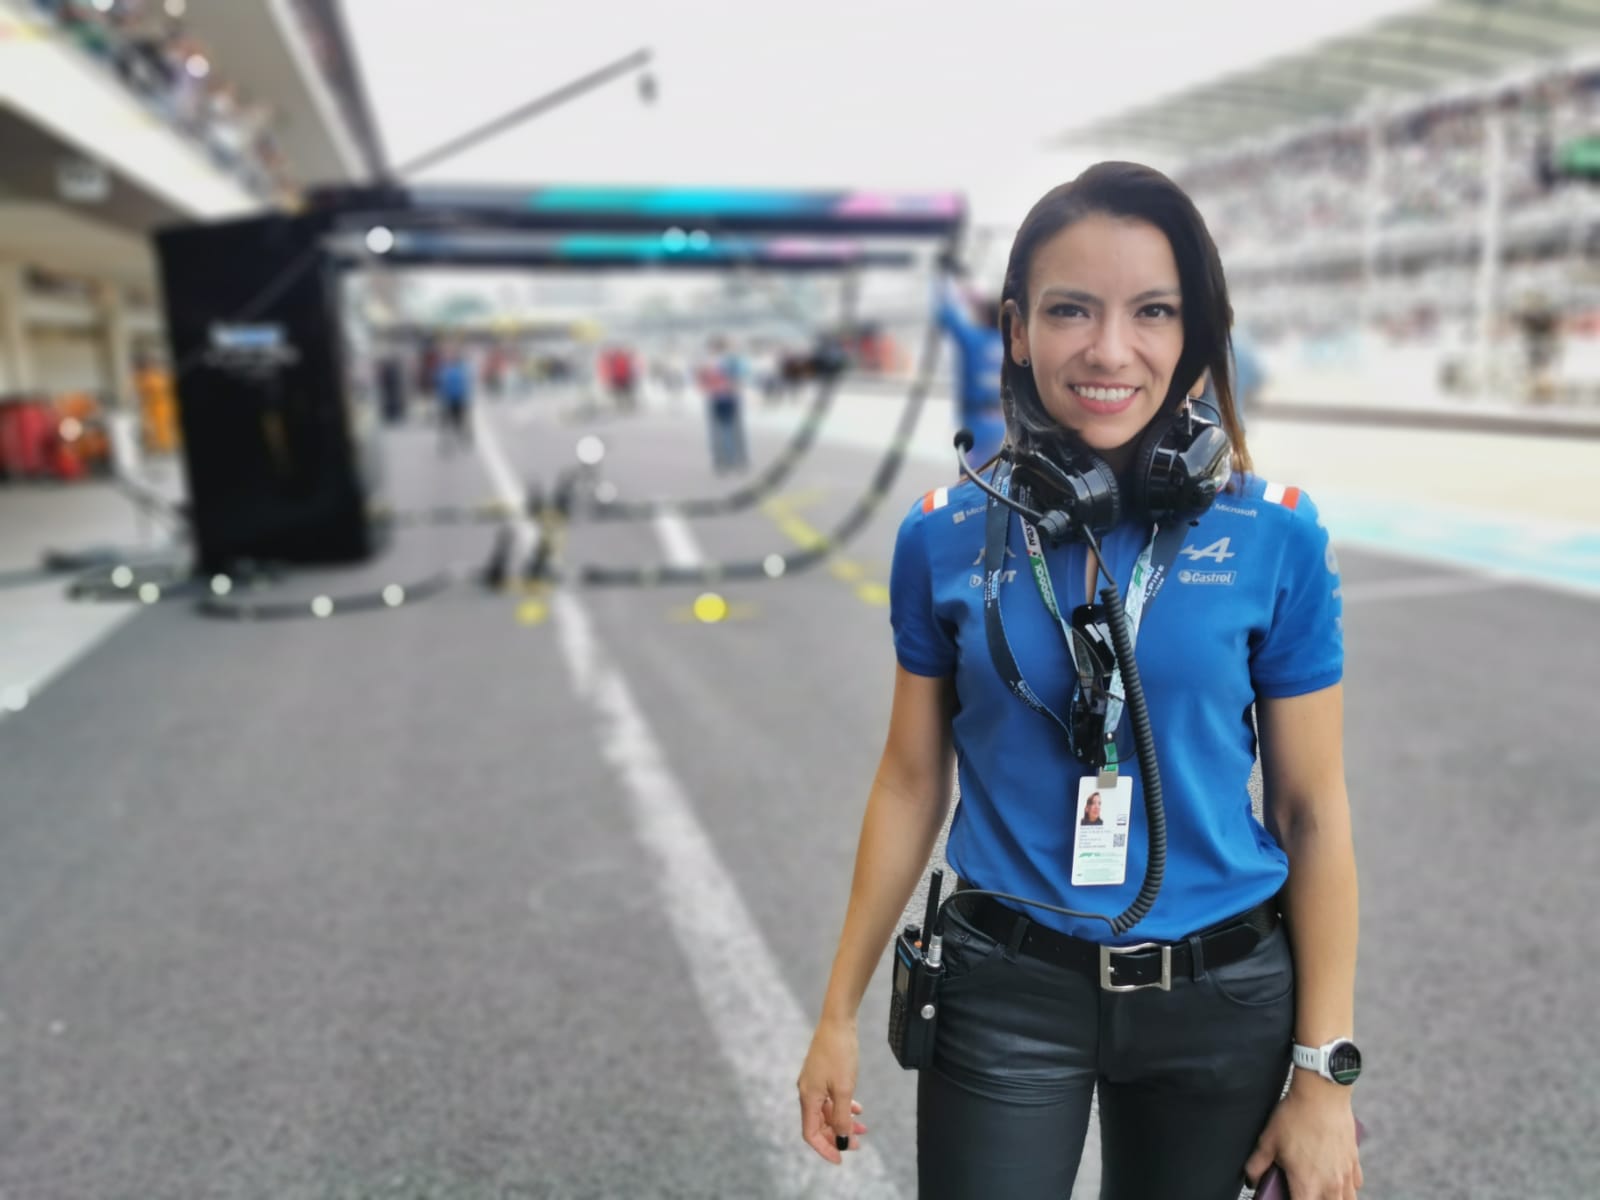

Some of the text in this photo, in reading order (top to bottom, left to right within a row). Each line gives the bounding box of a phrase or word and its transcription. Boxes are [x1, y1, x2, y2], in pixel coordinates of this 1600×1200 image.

[1215, 503, 1257, 518] Microsoft
[1143, 564, 1165, 604] ALPINE
[1191, 571, 1233, 584] Castrol
